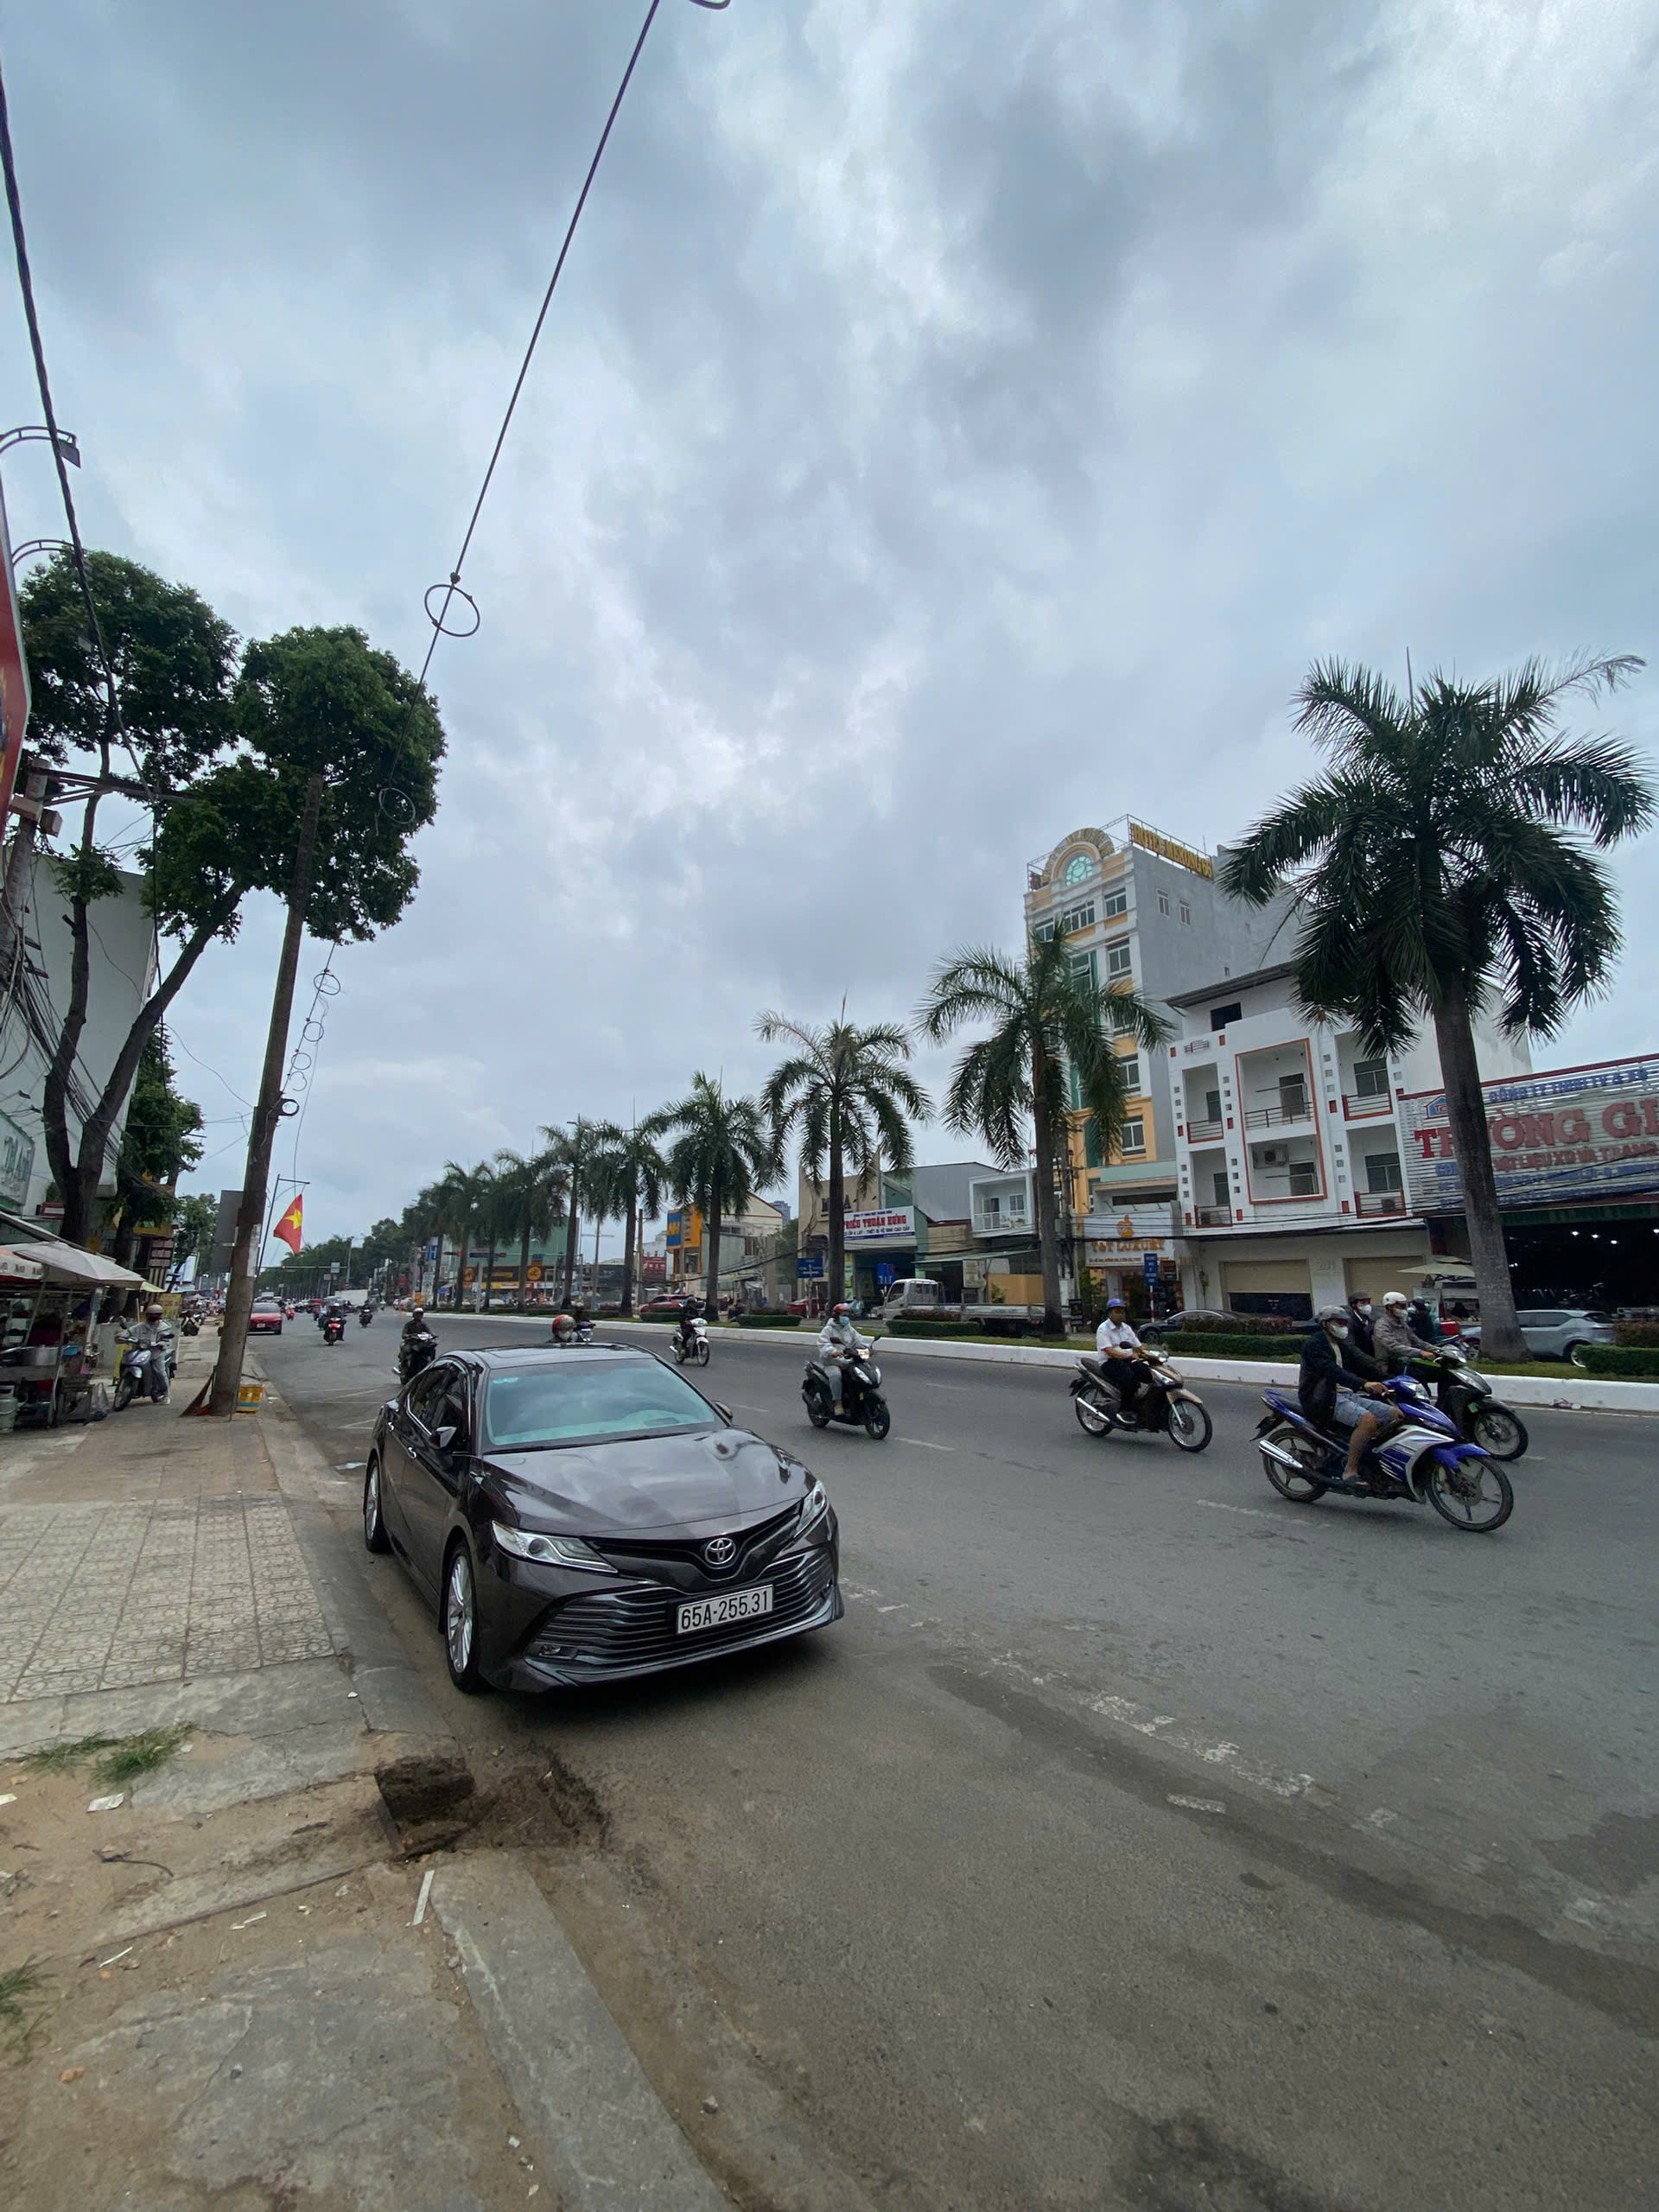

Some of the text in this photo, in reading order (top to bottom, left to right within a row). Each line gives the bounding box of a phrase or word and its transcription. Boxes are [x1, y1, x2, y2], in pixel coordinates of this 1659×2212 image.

[1133, 823, 1160, 855] HOTEL
[1603, 1099, 1659, 1138] GI
[681, 1590, 768, 1630] 65A-255.31
